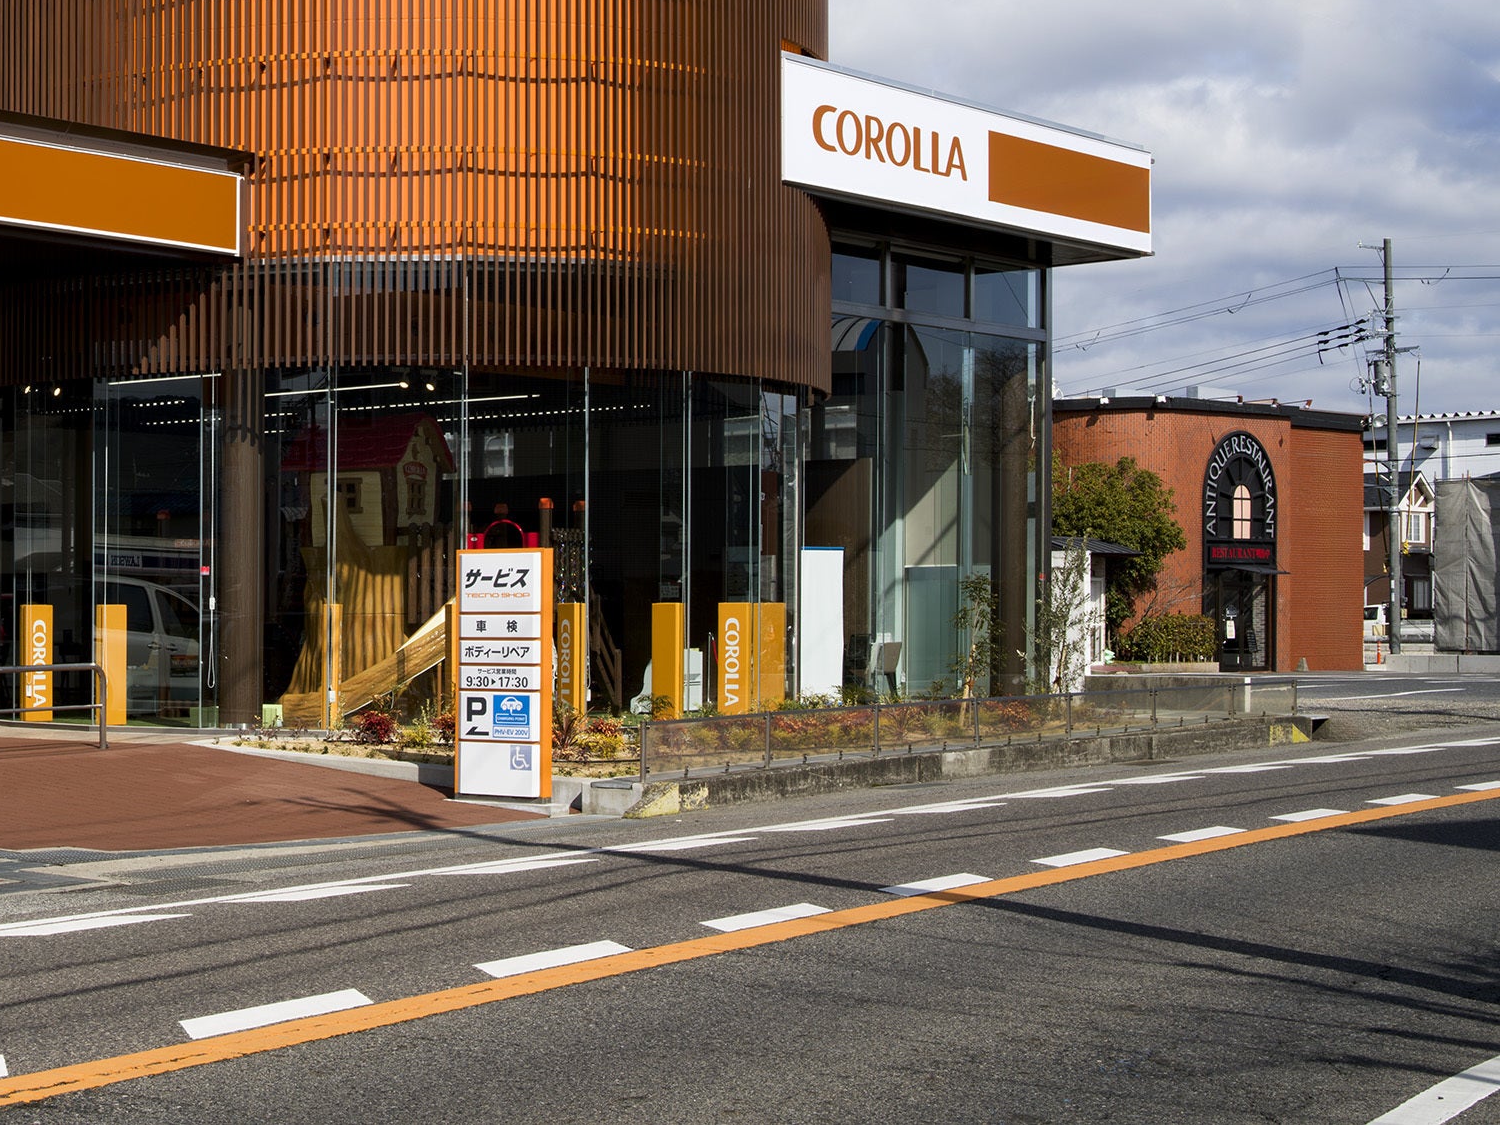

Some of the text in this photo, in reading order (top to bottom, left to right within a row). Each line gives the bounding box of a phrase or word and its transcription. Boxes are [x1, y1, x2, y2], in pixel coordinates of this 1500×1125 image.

[812, 104, 967, 182] COROLLA
[465, 568, 530, 589] サービス
[476, 619, 518, 633] 車検
[464, 645, 530, 659] ボディーリペア
[725, 617, 740, 707] COROLLA
[466, 675, 528, 688] 9:30 17:30
[466, 696, 487, 722] P
